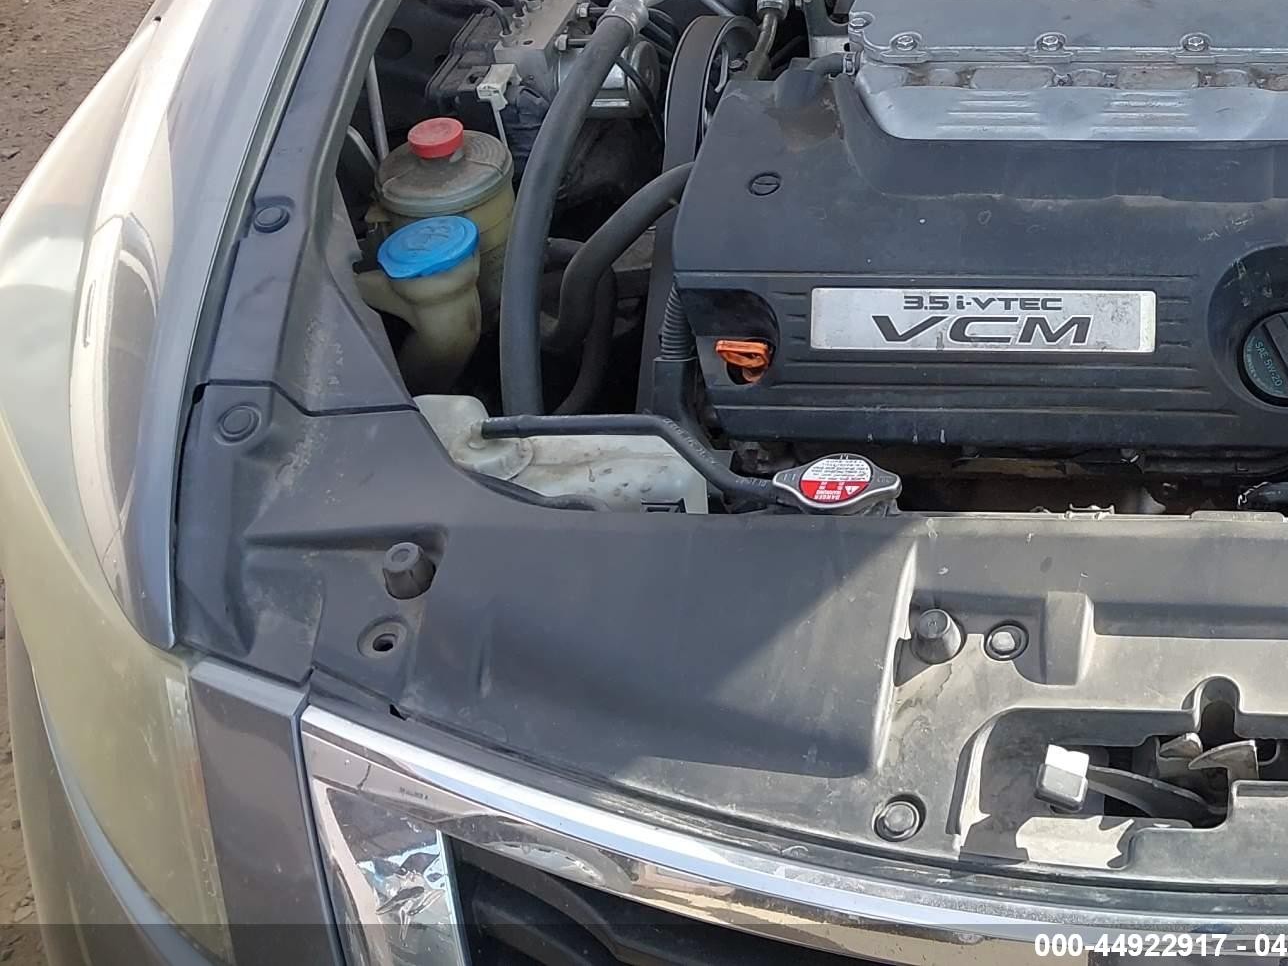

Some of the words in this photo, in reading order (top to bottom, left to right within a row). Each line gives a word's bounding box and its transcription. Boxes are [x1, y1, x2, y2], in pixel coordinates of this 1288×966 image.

[903, 295, 949, 311] 3.5
[956, 294, 1063, 311] i-VTEC
[870, 314, 1093, 345] VCM
[1255, 340, 1268, 359] SAE
[1263, 358, 1284, 387] 5W-20
